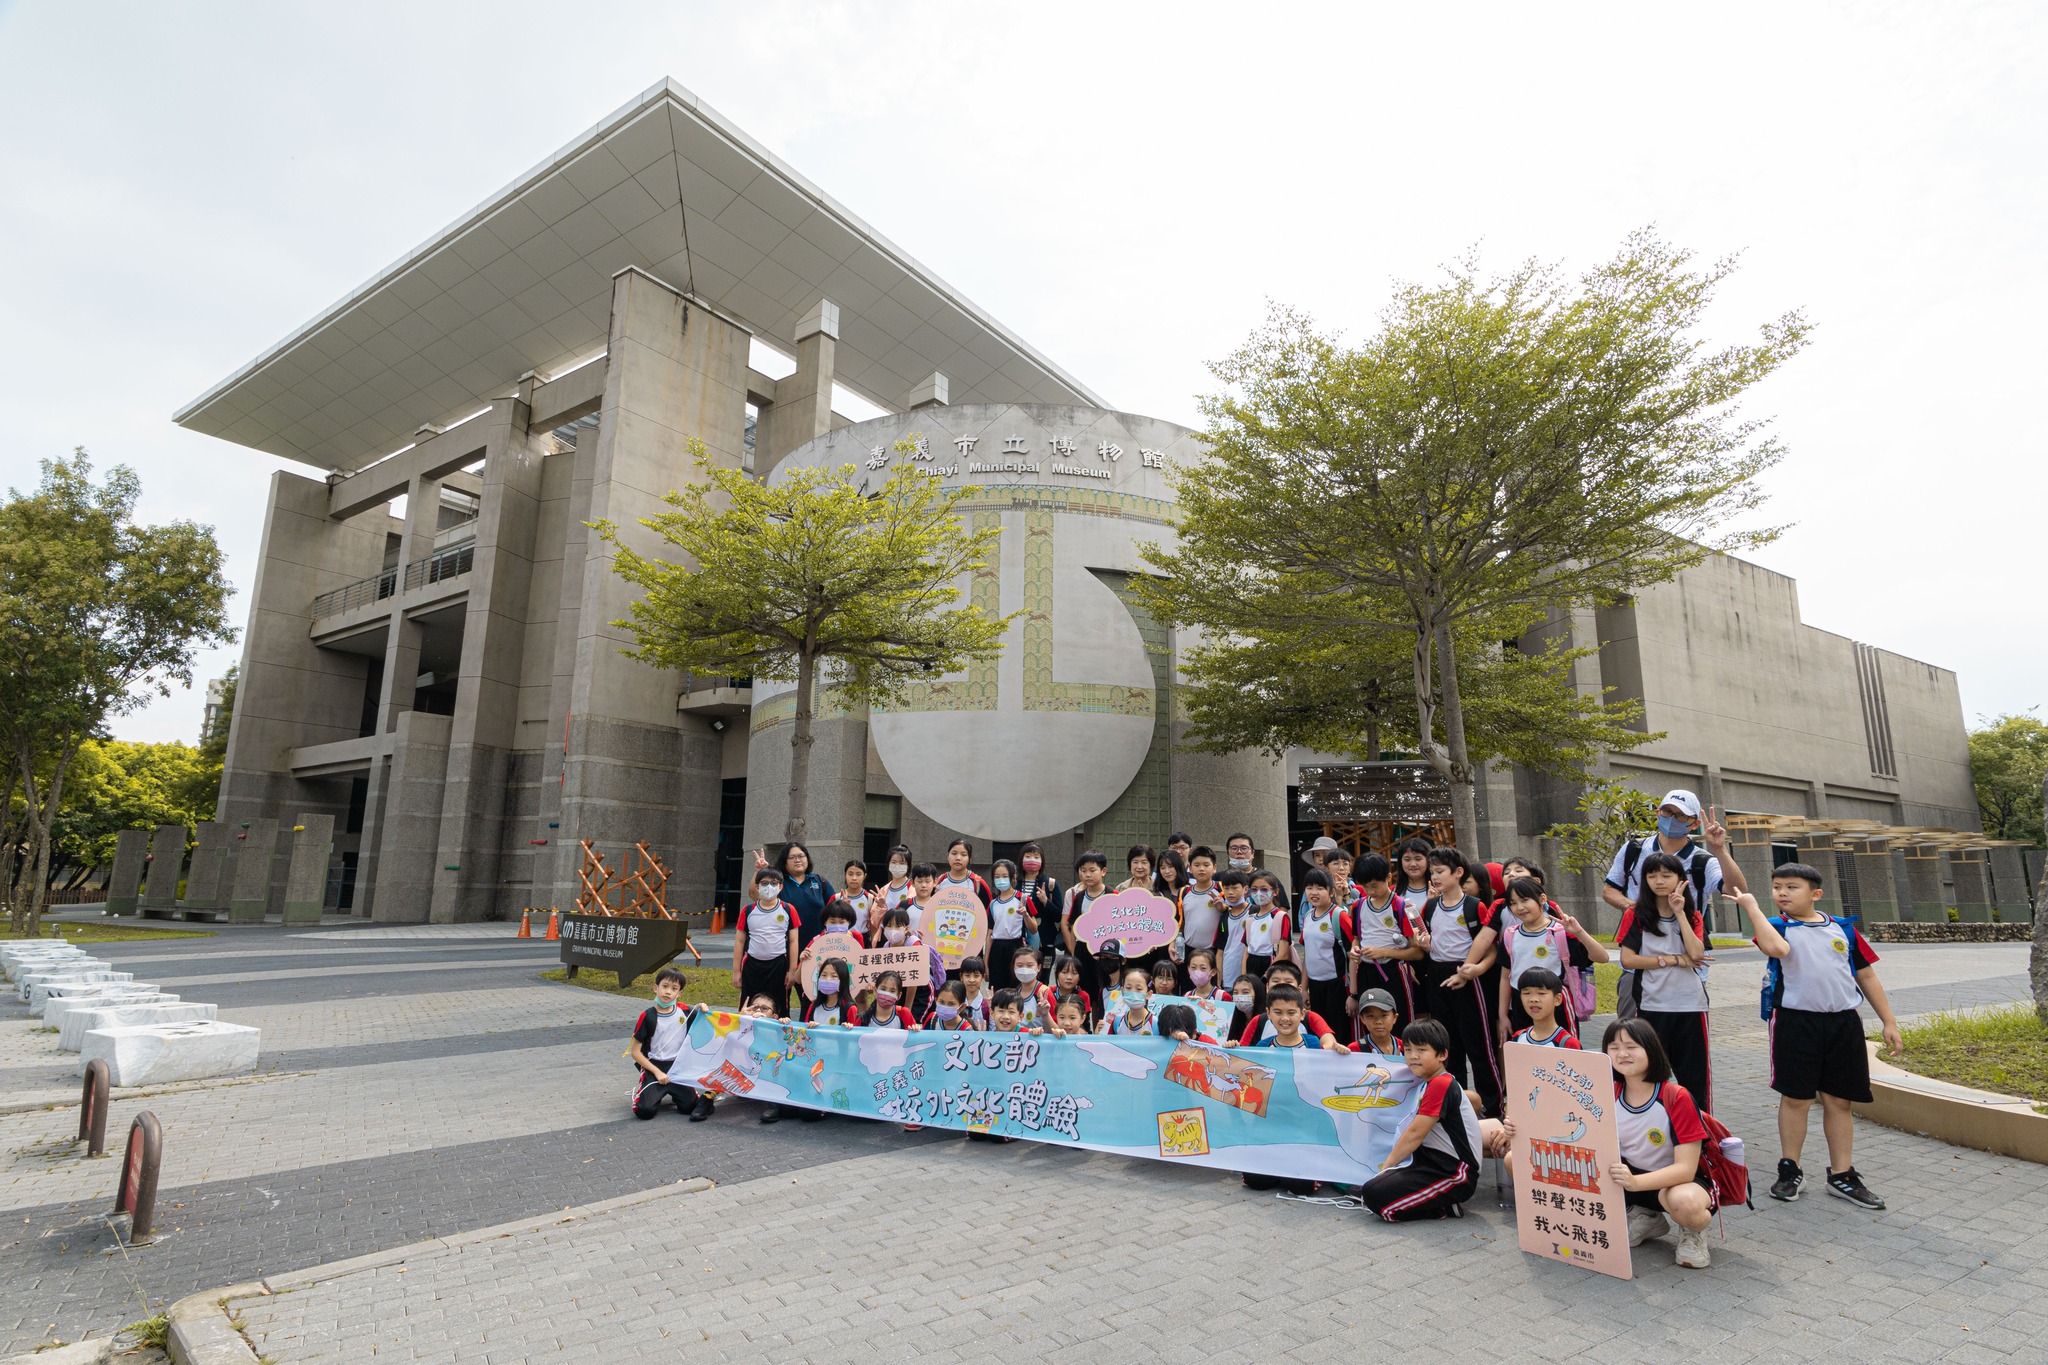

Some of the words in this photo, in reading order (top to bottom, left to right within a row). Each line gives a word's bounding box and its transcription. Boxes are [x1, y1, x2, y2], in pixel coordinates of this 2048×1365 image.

[865, 434, 1165, 470] 嘉義市立博物館
[969, 462, 1040, 474] Municipal
[1052, 463, 1111, 479] Museum
[1092, 917, 1166, 938] 校外文化體驗
[1111, 904, 1148, 919] 文化部
[573, 922, 639, 945] 嘉義市立博物館
[602, 949, 623, 958] MUSEUM
[858, 951, 920, 966] 這裡很好玩
[858, 969, 920, 985] 大家起來
[942, 1033, 1041, 1074] 文化部
[873, 1061, 926, 1102] 嘉義市
[1555, 1059, 1594, 1091] 文化部
[1532, 1065, 1604, 1122] 校外文化體驗
[880, 1080, 1081, 1142] 校外文化體驗
[1531, 1188, 1607, 1222] 樂聲悠揚
[1534, 1215, 1610, 1250] 我心飛揚
